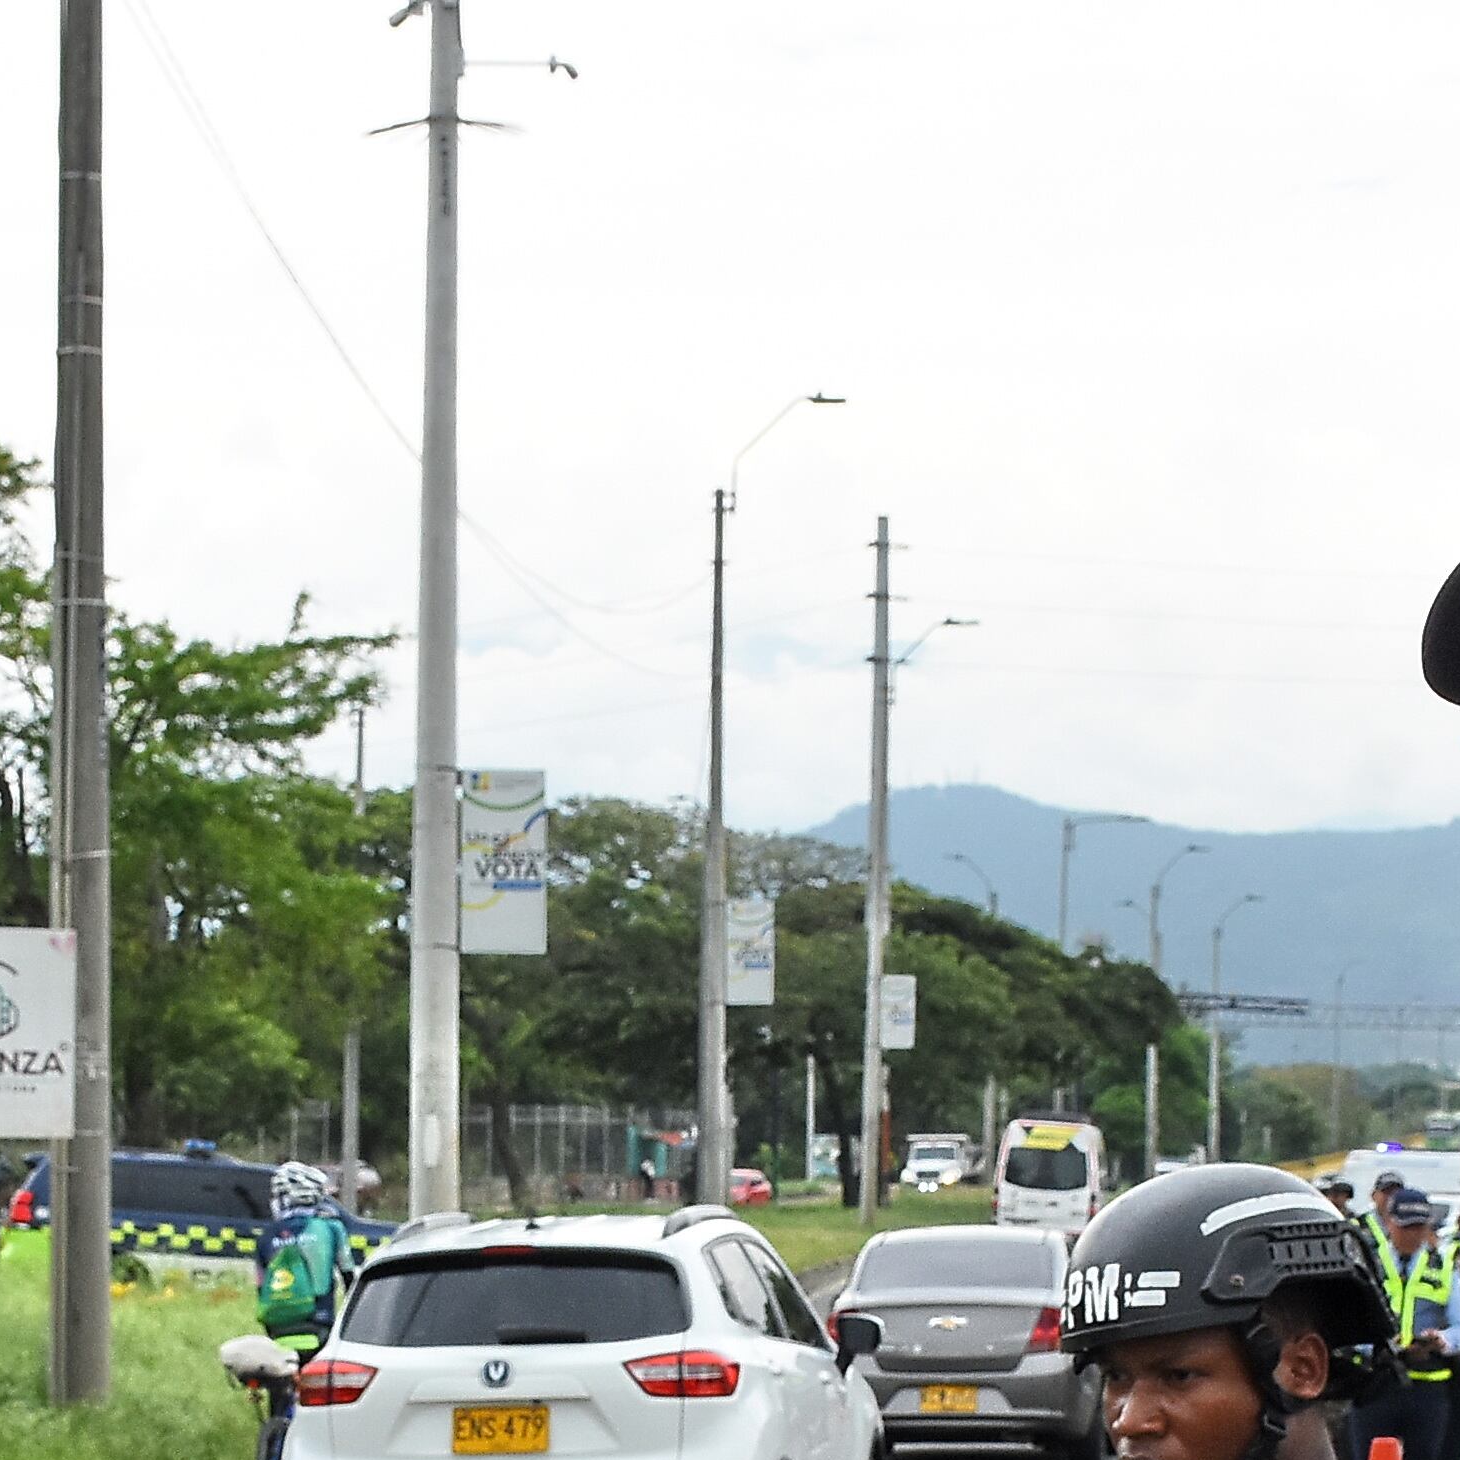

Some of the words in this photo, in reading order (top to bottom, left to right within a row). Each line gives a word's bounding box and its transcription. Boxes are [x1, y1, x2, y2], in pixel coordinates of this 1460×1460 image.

[474, 859, 540, 880] VOTA
[1068, 1263, 1120, 1329] PM
[456, 1415, 497, 1440] ENS
[503, 1413, 544, 1439] 479
